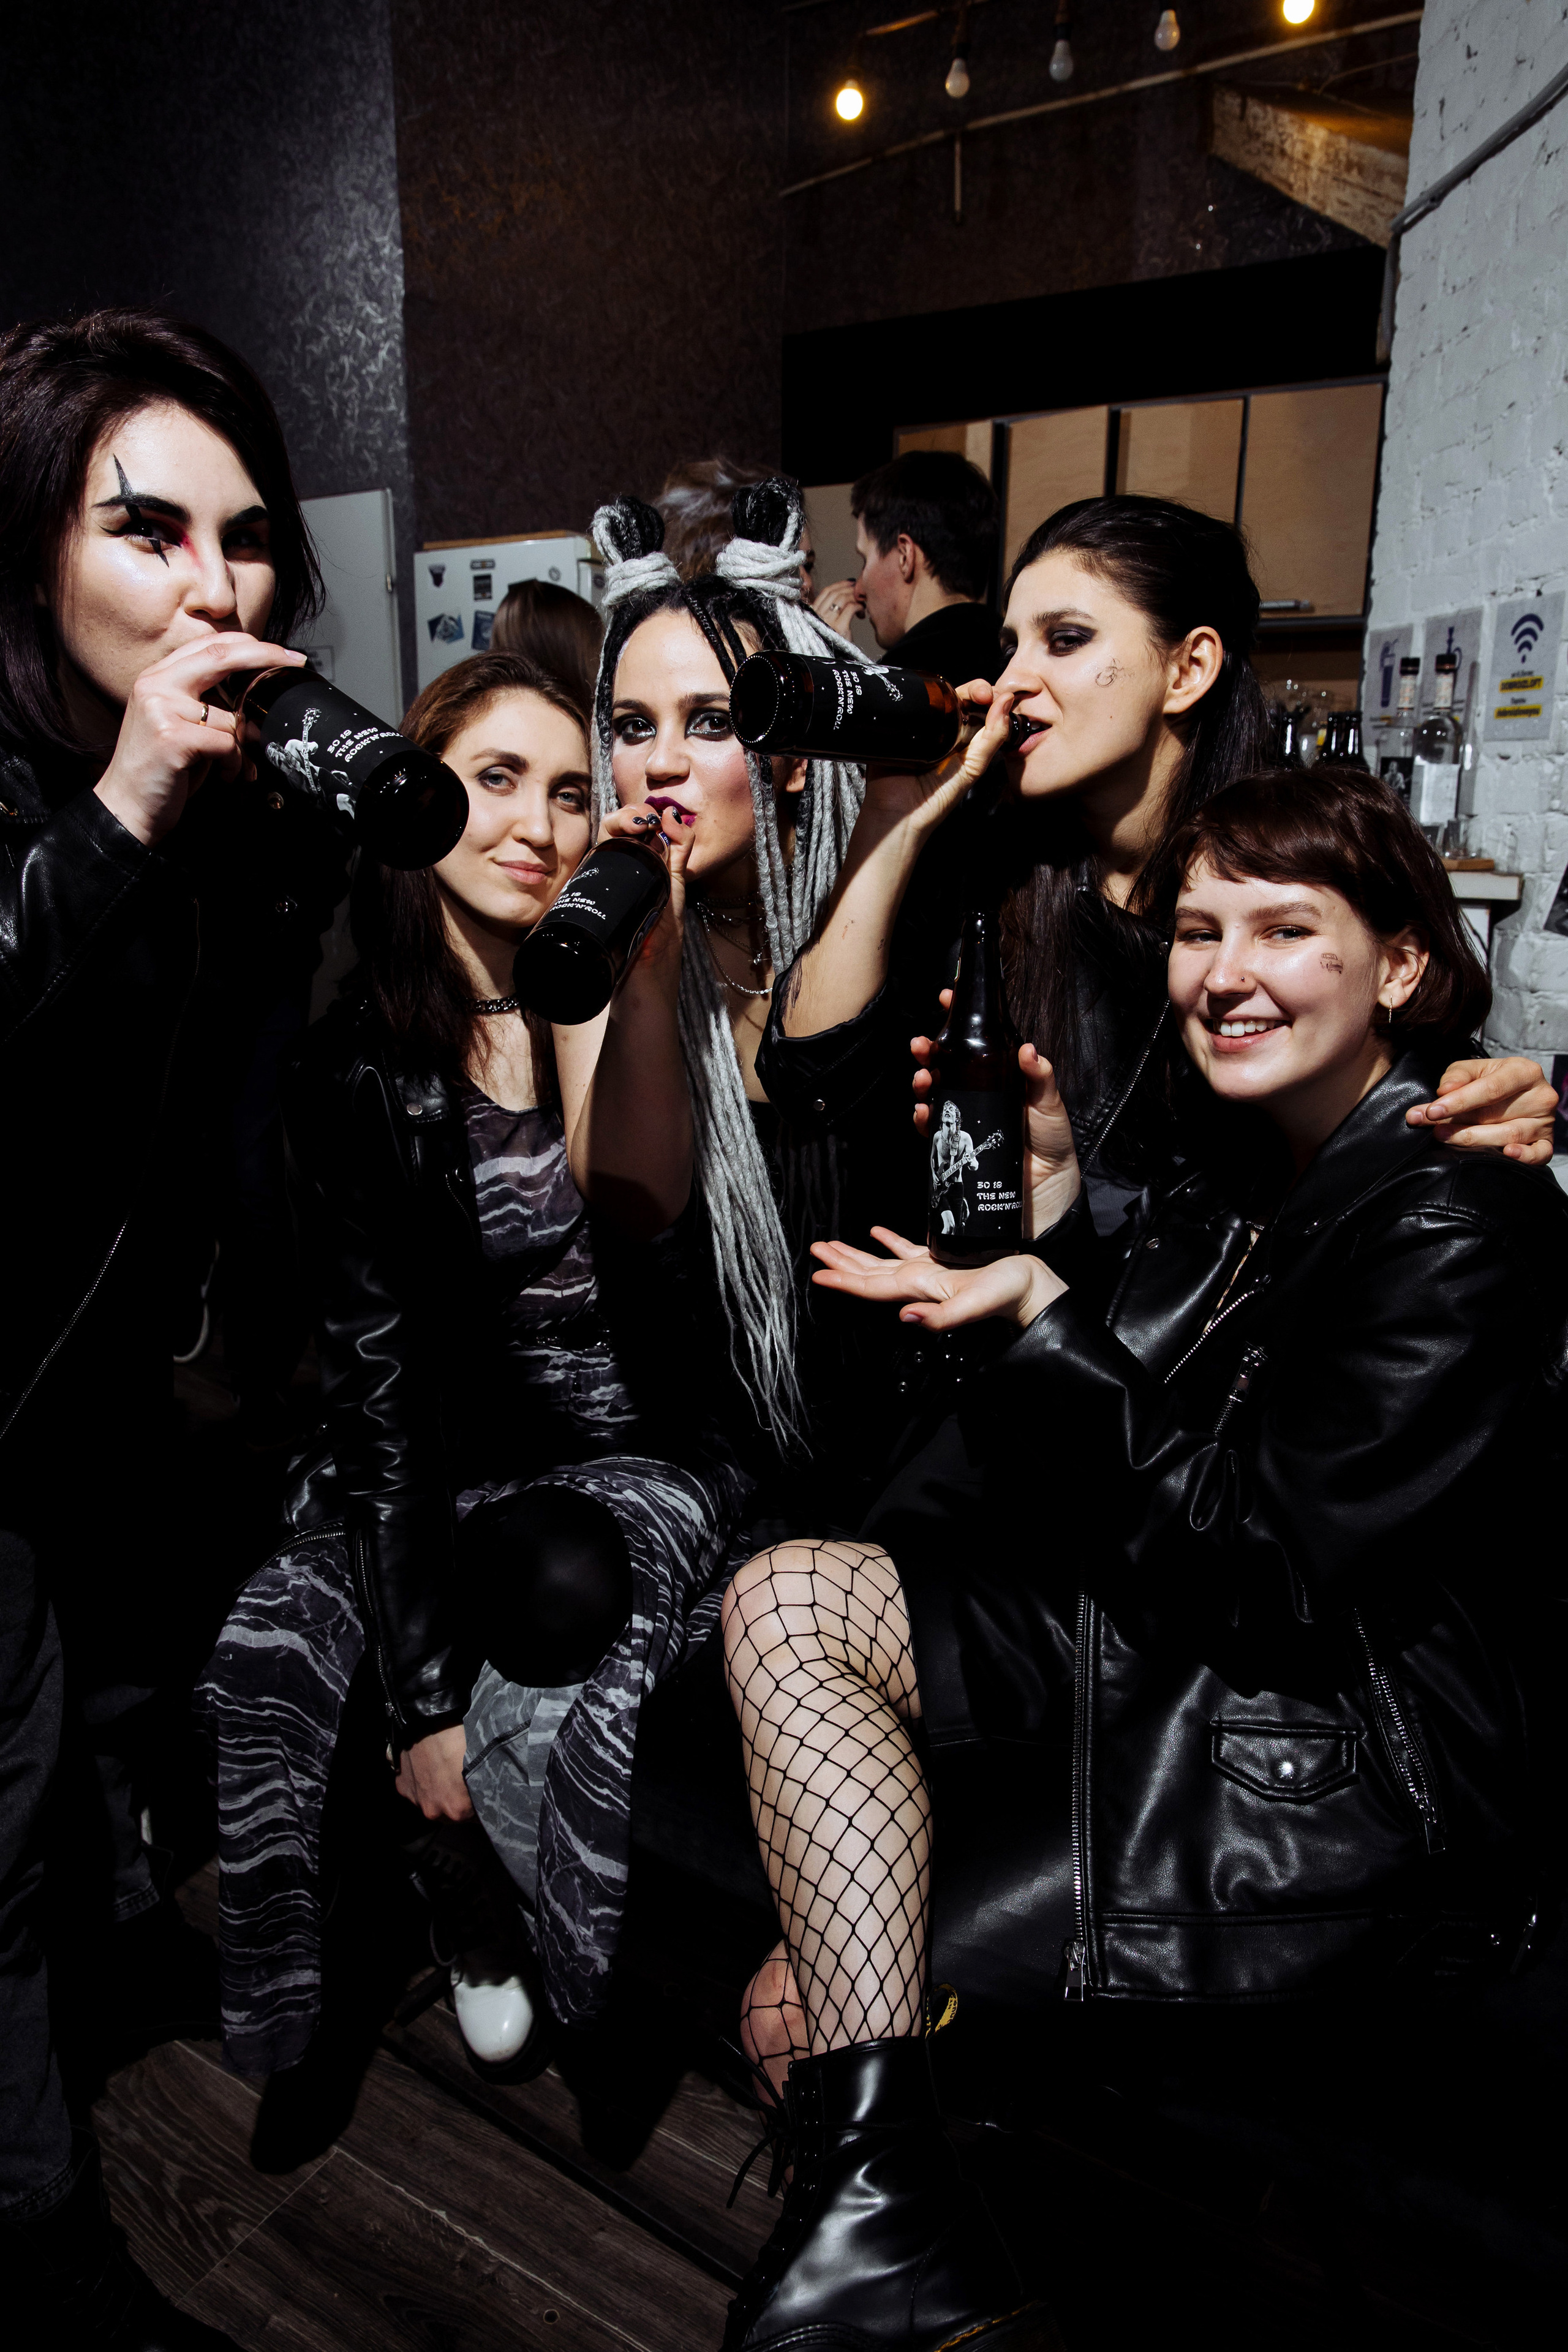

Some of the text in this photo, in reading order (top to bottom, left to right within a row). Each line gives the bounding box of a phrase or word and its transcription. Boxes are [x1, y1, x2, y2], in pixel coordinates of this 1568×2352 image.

[842, 669, 852, 687] THE
[335, 727, 379, 758] THE NEW
[554, 897, 571, 906] THE
[998, 1191, 1016, 1200] NEW
